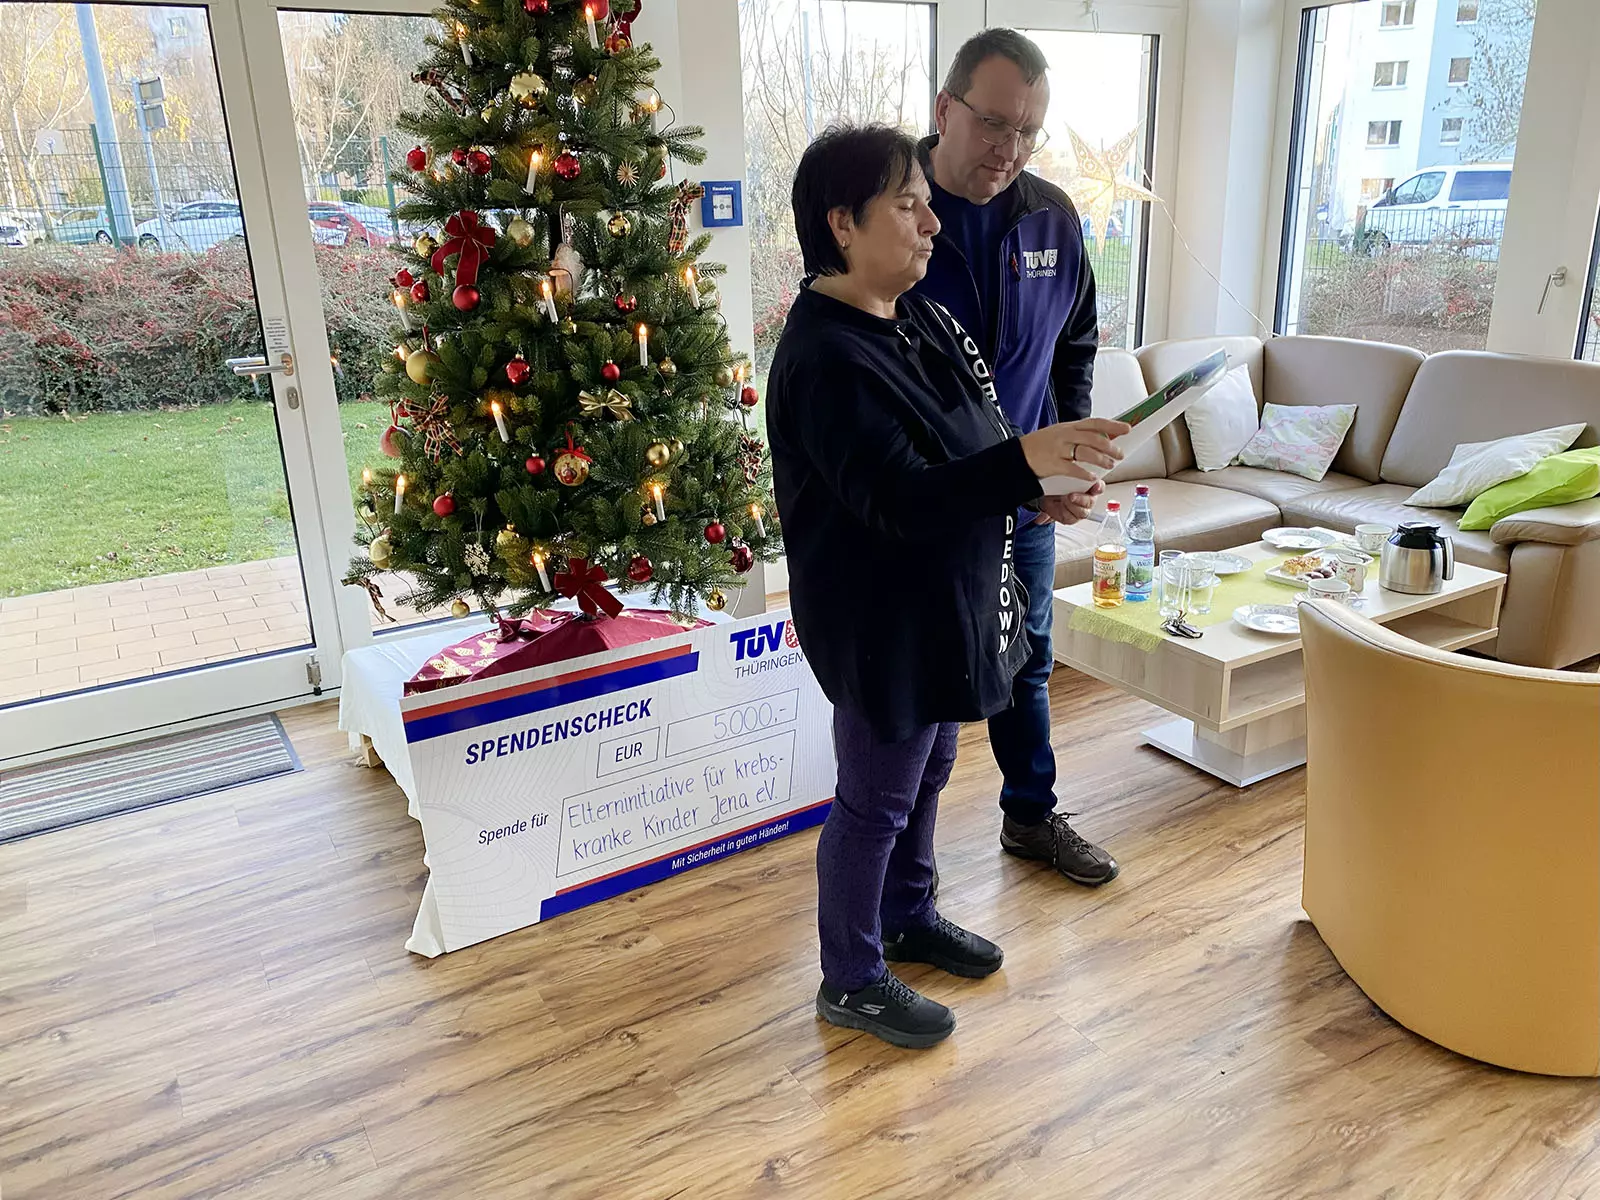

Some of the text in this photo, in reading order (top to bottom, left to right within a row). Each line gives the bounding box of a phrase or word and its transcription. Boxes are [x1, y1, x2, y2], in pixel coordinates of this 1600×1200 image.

[729, 620, 786, 662] TÜV
[734, 652, 804, 679] THÜRINGEN
[465, 697, 653, 765] SPENDENSCHECK
[615, 741, 643, 763] EUR
[568, 752, 785, 829] Elterninitiative für krebs-
[478, 812, 549, 846] Spende für
[572, 828, 633, 861] kranke
[642, 806, 700, 840] Kinder
[710, 793, 750, 826] Jena
[671, 820, 790, 870] Mit Sicherheit in guten Händen!
